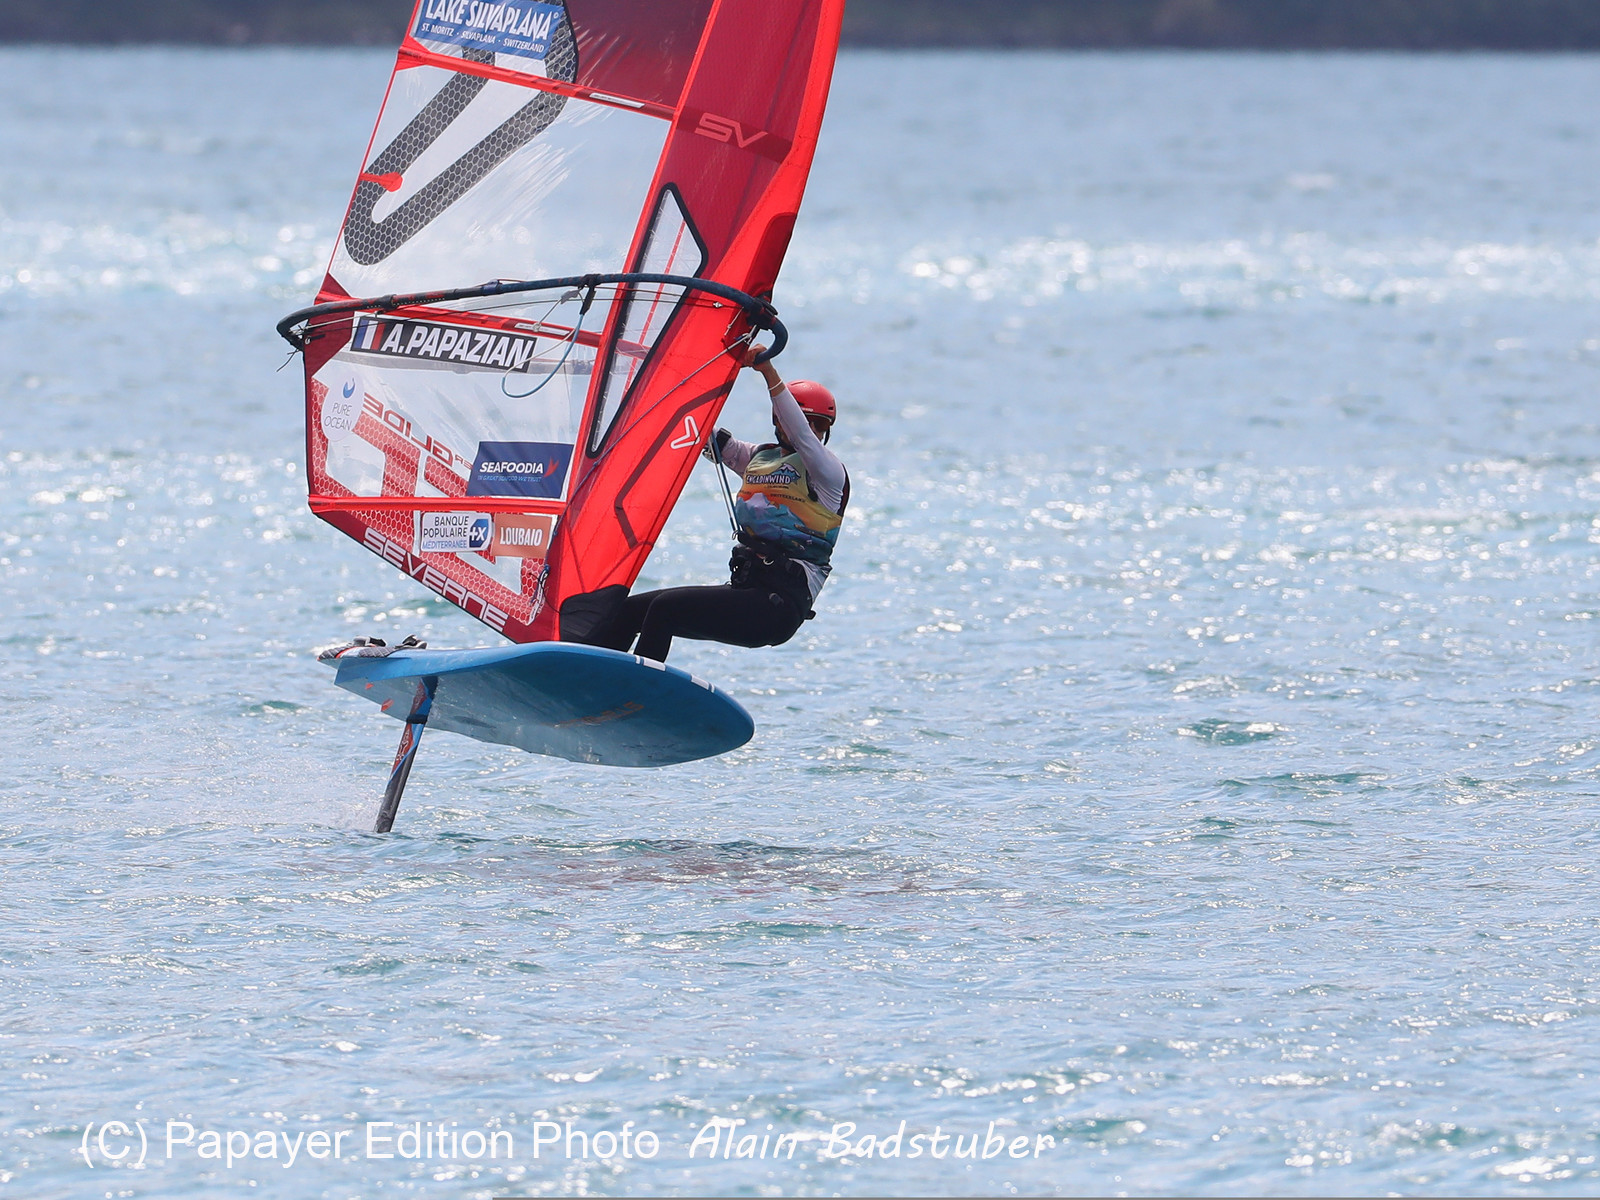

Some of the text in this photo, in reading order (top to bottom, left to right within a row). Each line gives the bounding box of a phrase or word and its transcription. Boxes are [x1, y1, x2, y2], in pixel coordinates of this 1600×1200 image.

[465, 0, 553, 41] SILVAPLANA
[421, 23, 545, 53] ST. MORITZ SILVAPLANA SWITZERLAND
[380, 323, 535, 370] A.PAPAZIAN
[332, 402, 353, 417] PURE
[323, 415, 352, 431] OCEAN
[479, 461, 544, 474] SEAFOODIA
[434, 516, 469, 527] BANQUE
[423, 527, 468, 538] POPULAIRE
[500, 527, 543, 546] LOUBAIO
[363, 528, 509, 632] SEVERNE
